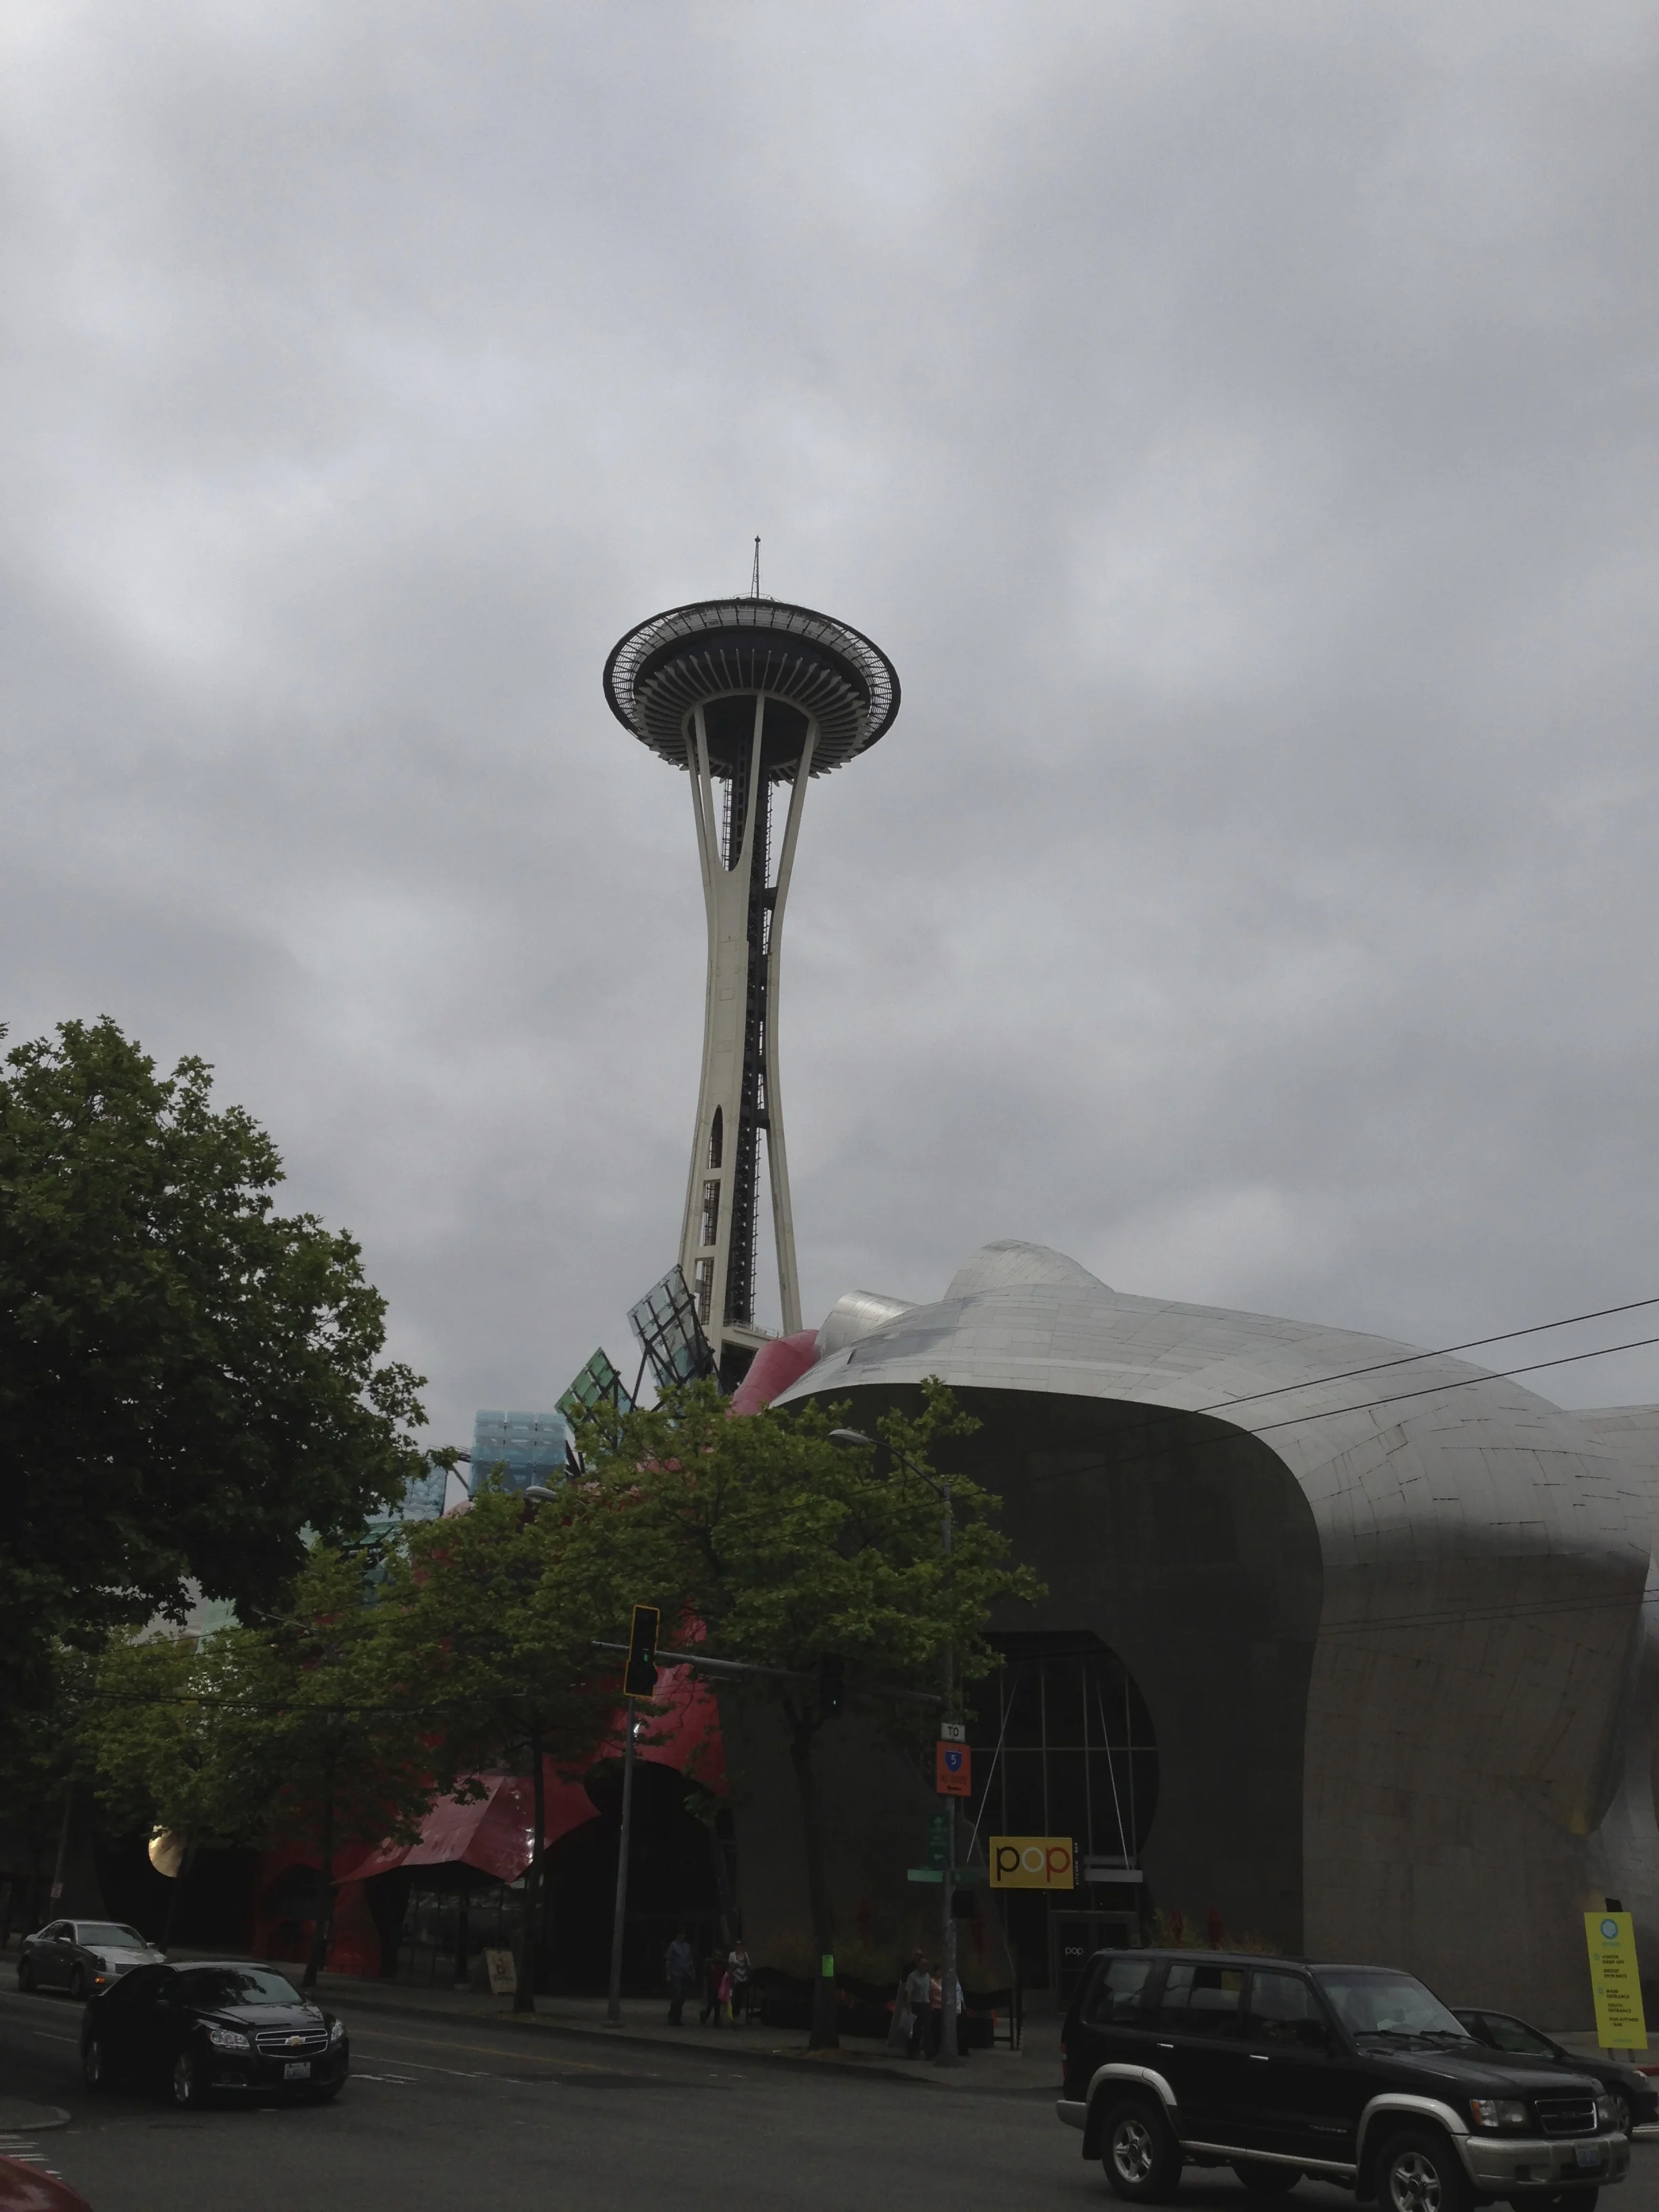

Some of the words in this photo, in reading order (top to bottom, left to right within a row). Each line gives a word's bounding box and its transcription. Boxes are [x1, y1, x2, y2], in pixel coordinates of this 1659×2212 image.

[947, 1726, 959, 1737] TO
[951, 1755, 957, 1765] 5
[996, 1846, 1070, 1883] pop
[1065, 1947, 1084, 1957] pop
